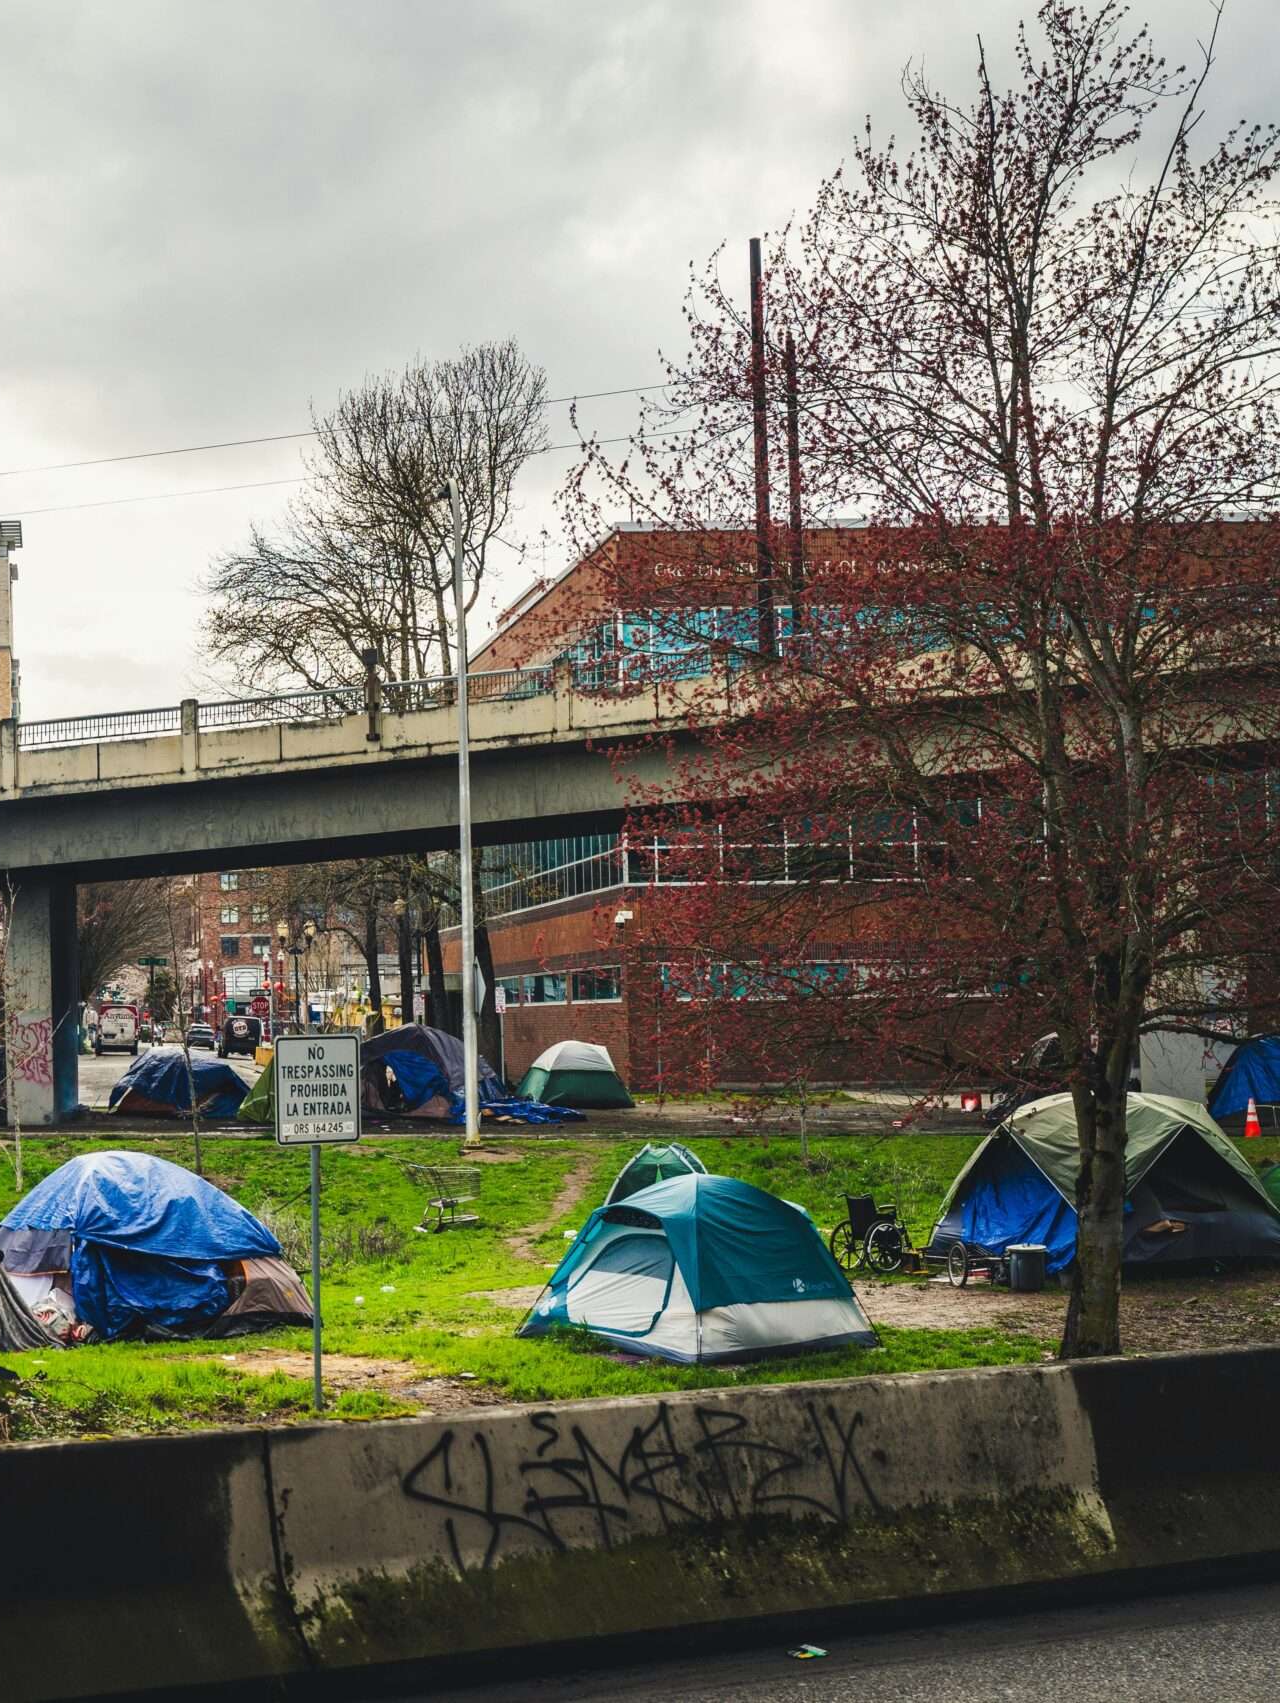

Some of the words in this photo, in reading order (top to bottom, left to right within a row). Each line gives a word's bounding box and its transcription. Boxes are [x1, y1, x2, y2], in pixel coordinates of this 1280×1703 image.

[252, 1001, 269, 1010] STOP
[308, 1046, 325, 1061] NO
[281, 1063, 354, 1079] TRESPASSING
[290, 1083, 347, 1098] PROHIBIDA
[286, 1103, 299, 1117] LA
[303, 1101, 352, 1116] ENTRADA
[293, 1123, 309, 1135] ORS
